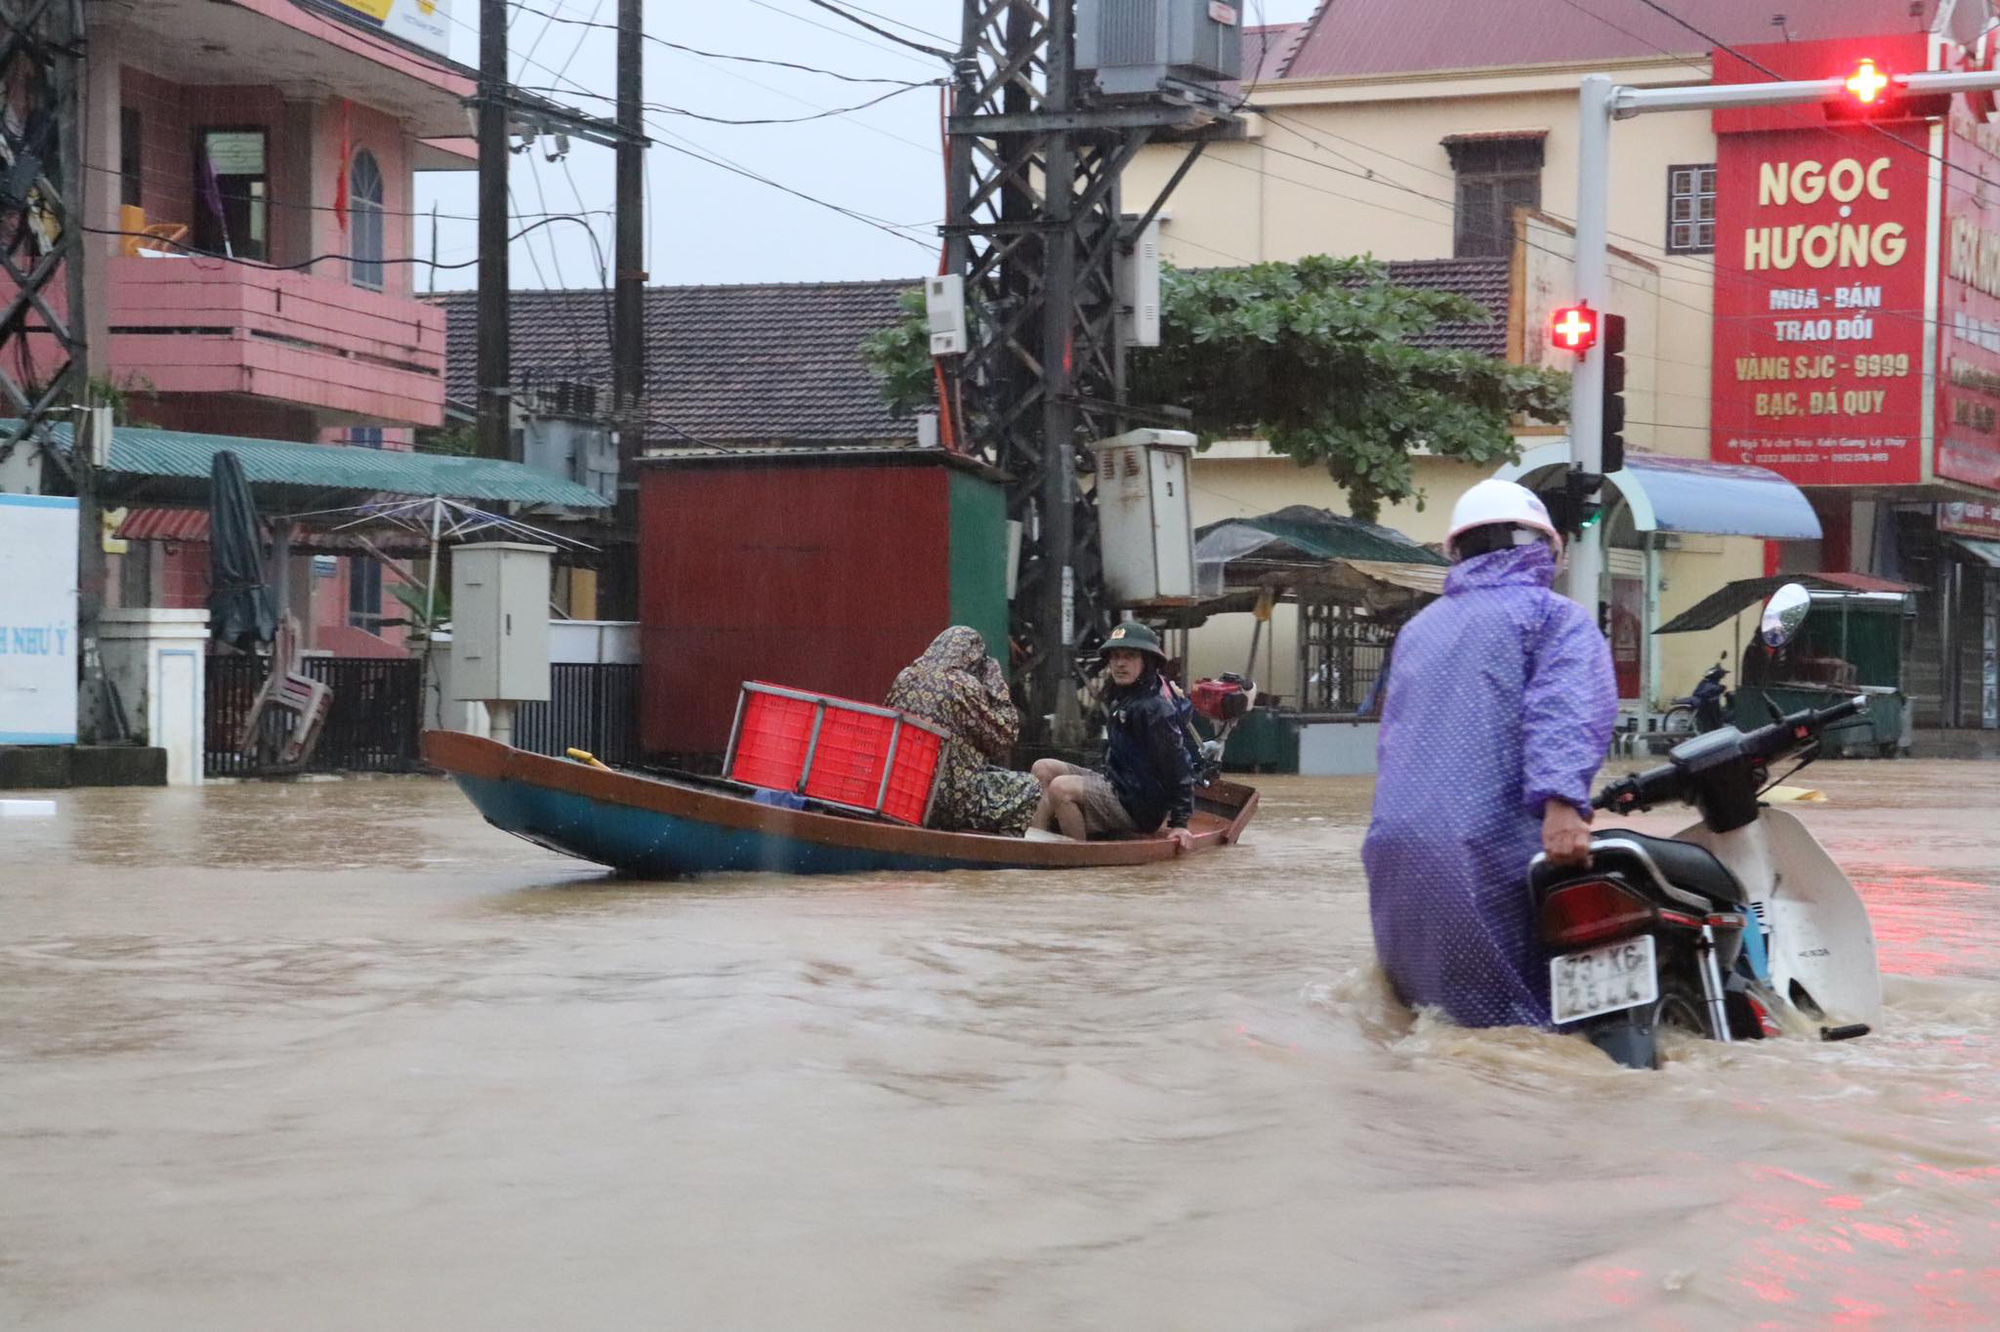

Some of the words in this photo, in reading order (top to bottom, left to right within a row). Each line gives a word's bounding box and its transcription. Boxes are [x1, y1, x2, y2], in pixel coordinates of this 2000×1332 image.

[1759, 157, 1890, 217] NGỌC
[1744, 222, 1906, 270] HƯƠNG
[1769, 289, 1819, 309] MUA
[1835, 282, 1881, 308] BÁN
[1774, 319, 1832, 341] TRAO
[1835, 310, 1873, 340] ĐỔI
[1736, 353, 1789, 380] VÀNG
[1794, 355, 1835, 379] SJC
[1854, 354, 1909, 378] 9999
[1810, 386, 1838, 414] ĐÁ
